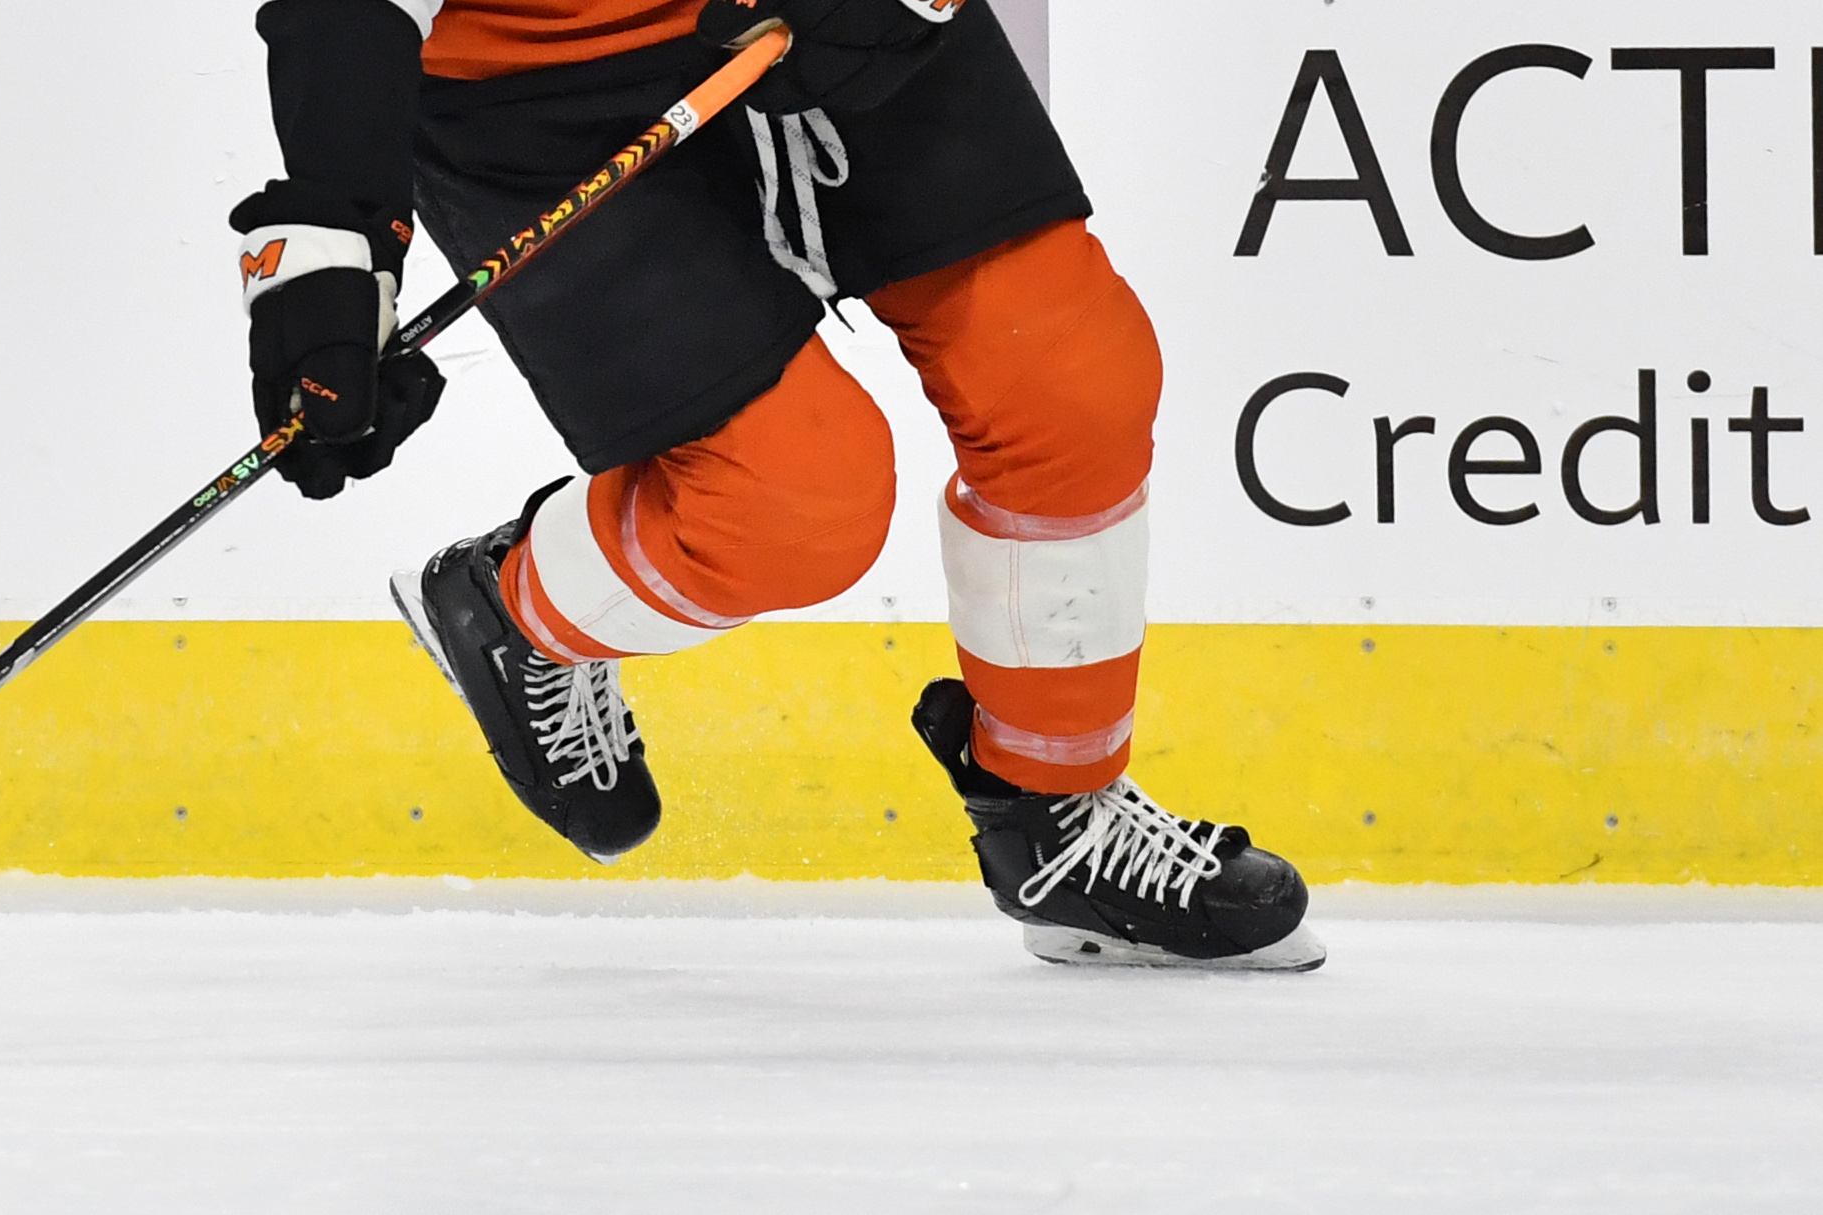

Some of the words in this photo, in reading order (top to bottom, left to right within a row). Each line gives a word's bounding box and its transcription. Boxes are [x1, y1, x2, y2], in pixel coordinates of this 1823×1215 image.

[670, 104, 693, 127] 23
[400, 315, 434, 344] ATTARD
[1234, 368, 1812, 527] Credit
